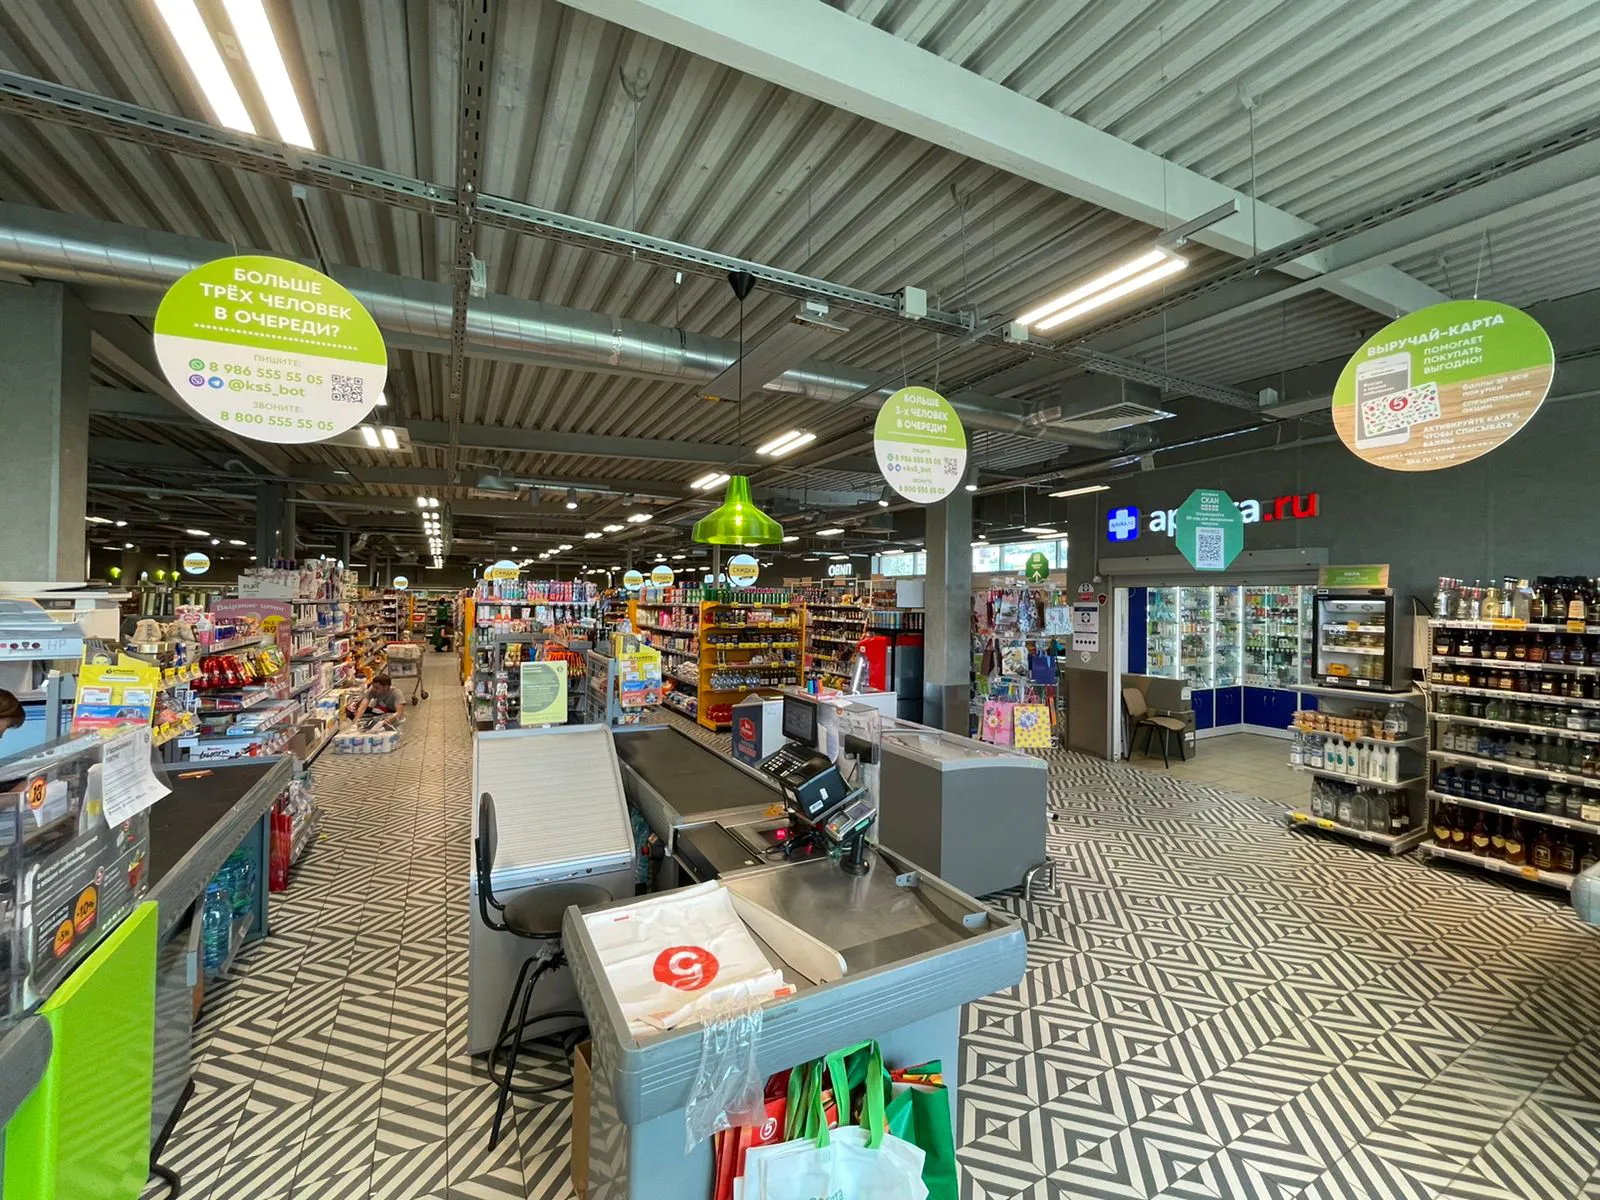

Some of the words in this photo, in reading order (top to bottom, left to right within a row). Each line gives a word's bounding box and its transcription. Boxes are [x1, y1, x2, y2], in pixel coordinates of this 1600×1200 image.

[234, 267, 322, 295] БОЛЬШЕ
[200, 282, 253, 304] ТРЁХ
[259, 293, 351, 321] ЧЕЛОВЕК
[214, 307, 227, 320] В
[235, 309, 339, 337] ОЧЕРЕДИ?
[1367, 314, 1505, 357] ВЫРУЧАЙ-КАРТА
[1424, 335, 1484, 356] ПОМОГАЕТ
[1424, 346, 1482, 365] ПОКУПАТЬ
[209, 361, 219, 372] 8
[224, 363, 251, 377] 986
[257, 367, 281, 380] 555
[286, 371, 302, 383] 55
[307, 374, 323, 385] 05
[1424, 356, 1482, 375] ВЫГОДНО!
[228, 379, 305, 397] @ks5_bot
[904, 394, 940, 406] БОЛЬШЕ
[220, 410, 229, 421] 8
[235, 411, 264, 425] 800
[268, 414, 292, 428] 555
[297, 417, 312, 430] 55
[318, 419, 334, 432] 05
[911, 408, 948, 421] ЧЕЛОВЕК
[897, 419, 902, 428] В
[904, 420, 947, 433] ОЧЕРЕДИ?
[1455, 422, 1513, 435] СПИСЫВАТЬ
[1150, 492, 1317, 537] apa.ru
[76, 901, 94, 918] -10%
[764, 1120, 772, 1136] 5
